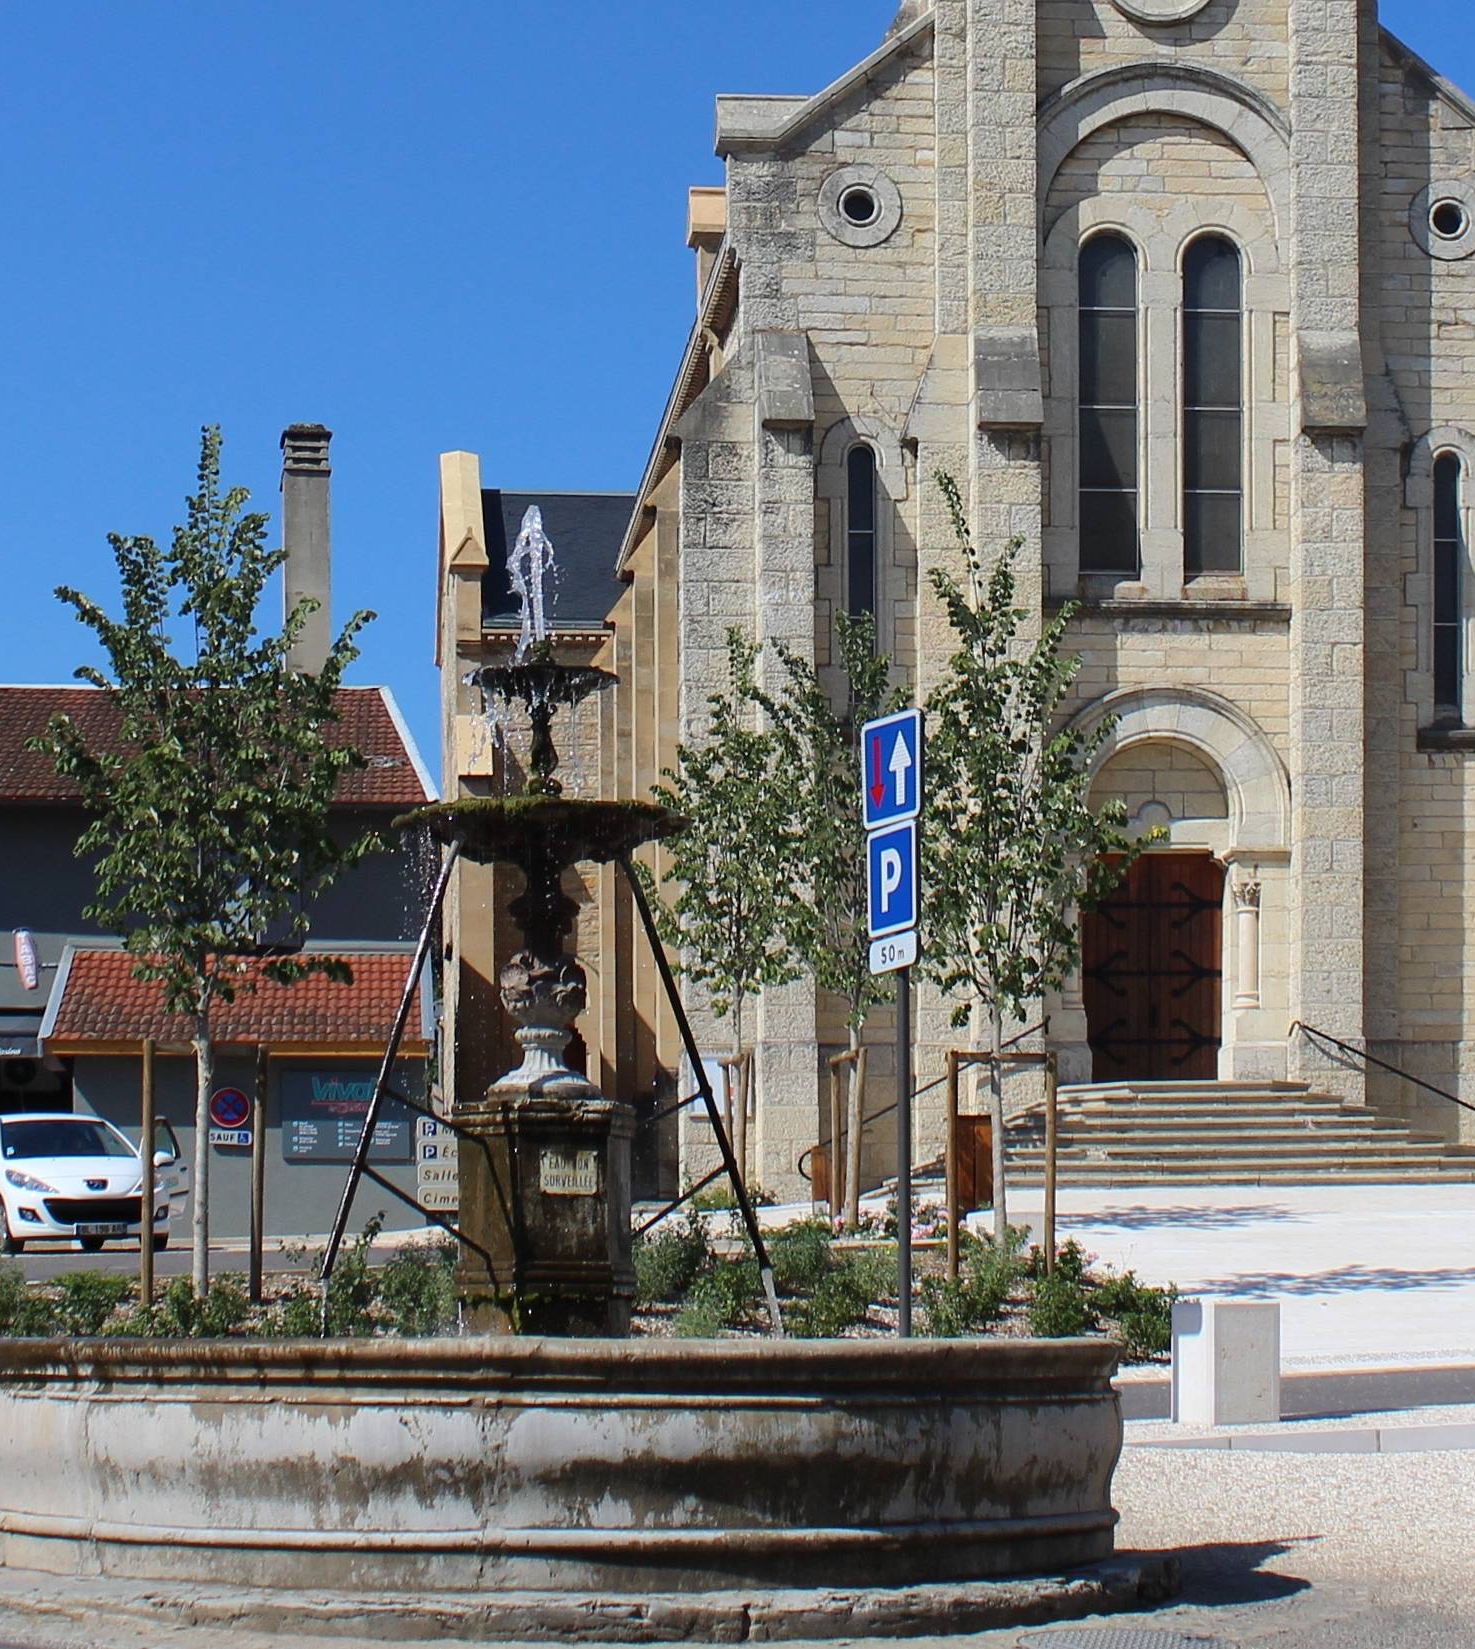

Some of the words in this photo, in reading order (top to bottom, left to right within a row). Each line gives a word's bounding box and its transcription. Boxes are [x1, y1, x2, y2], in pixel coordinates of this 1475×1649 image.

[881, 848, 902, 913] P
[311, 1076, 378, 1101] Vival
[209, 1132, 236, 1142] SAUF
[425, 1147, 435, 1158] P
